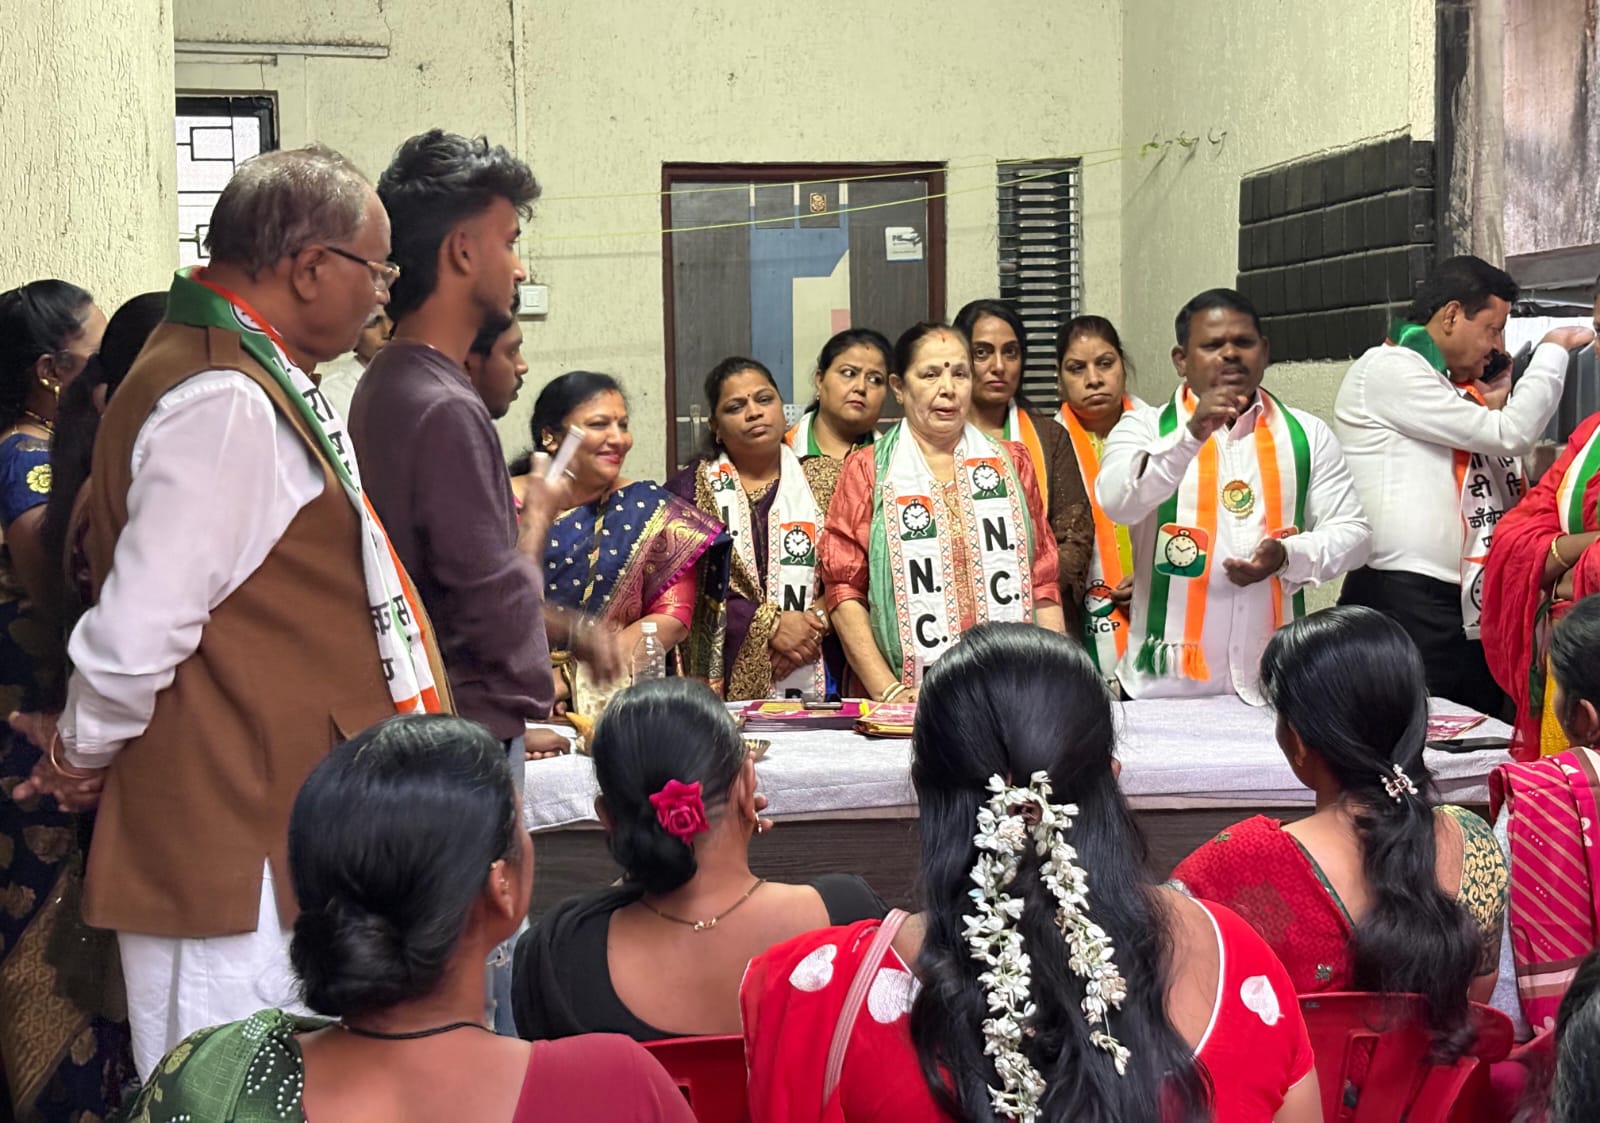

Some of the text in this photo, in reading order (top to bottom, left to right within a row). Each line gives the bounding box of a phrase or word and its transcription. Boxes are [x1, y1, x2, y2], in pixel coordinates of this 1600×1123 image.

[982, 517, 1015, 551] N.
[909, 558, 942, 594] N.
[990, 571, 1020, 605] C.
[916, 614, 948, 648] C.
[1087, 622, 1121, 634] NCP
